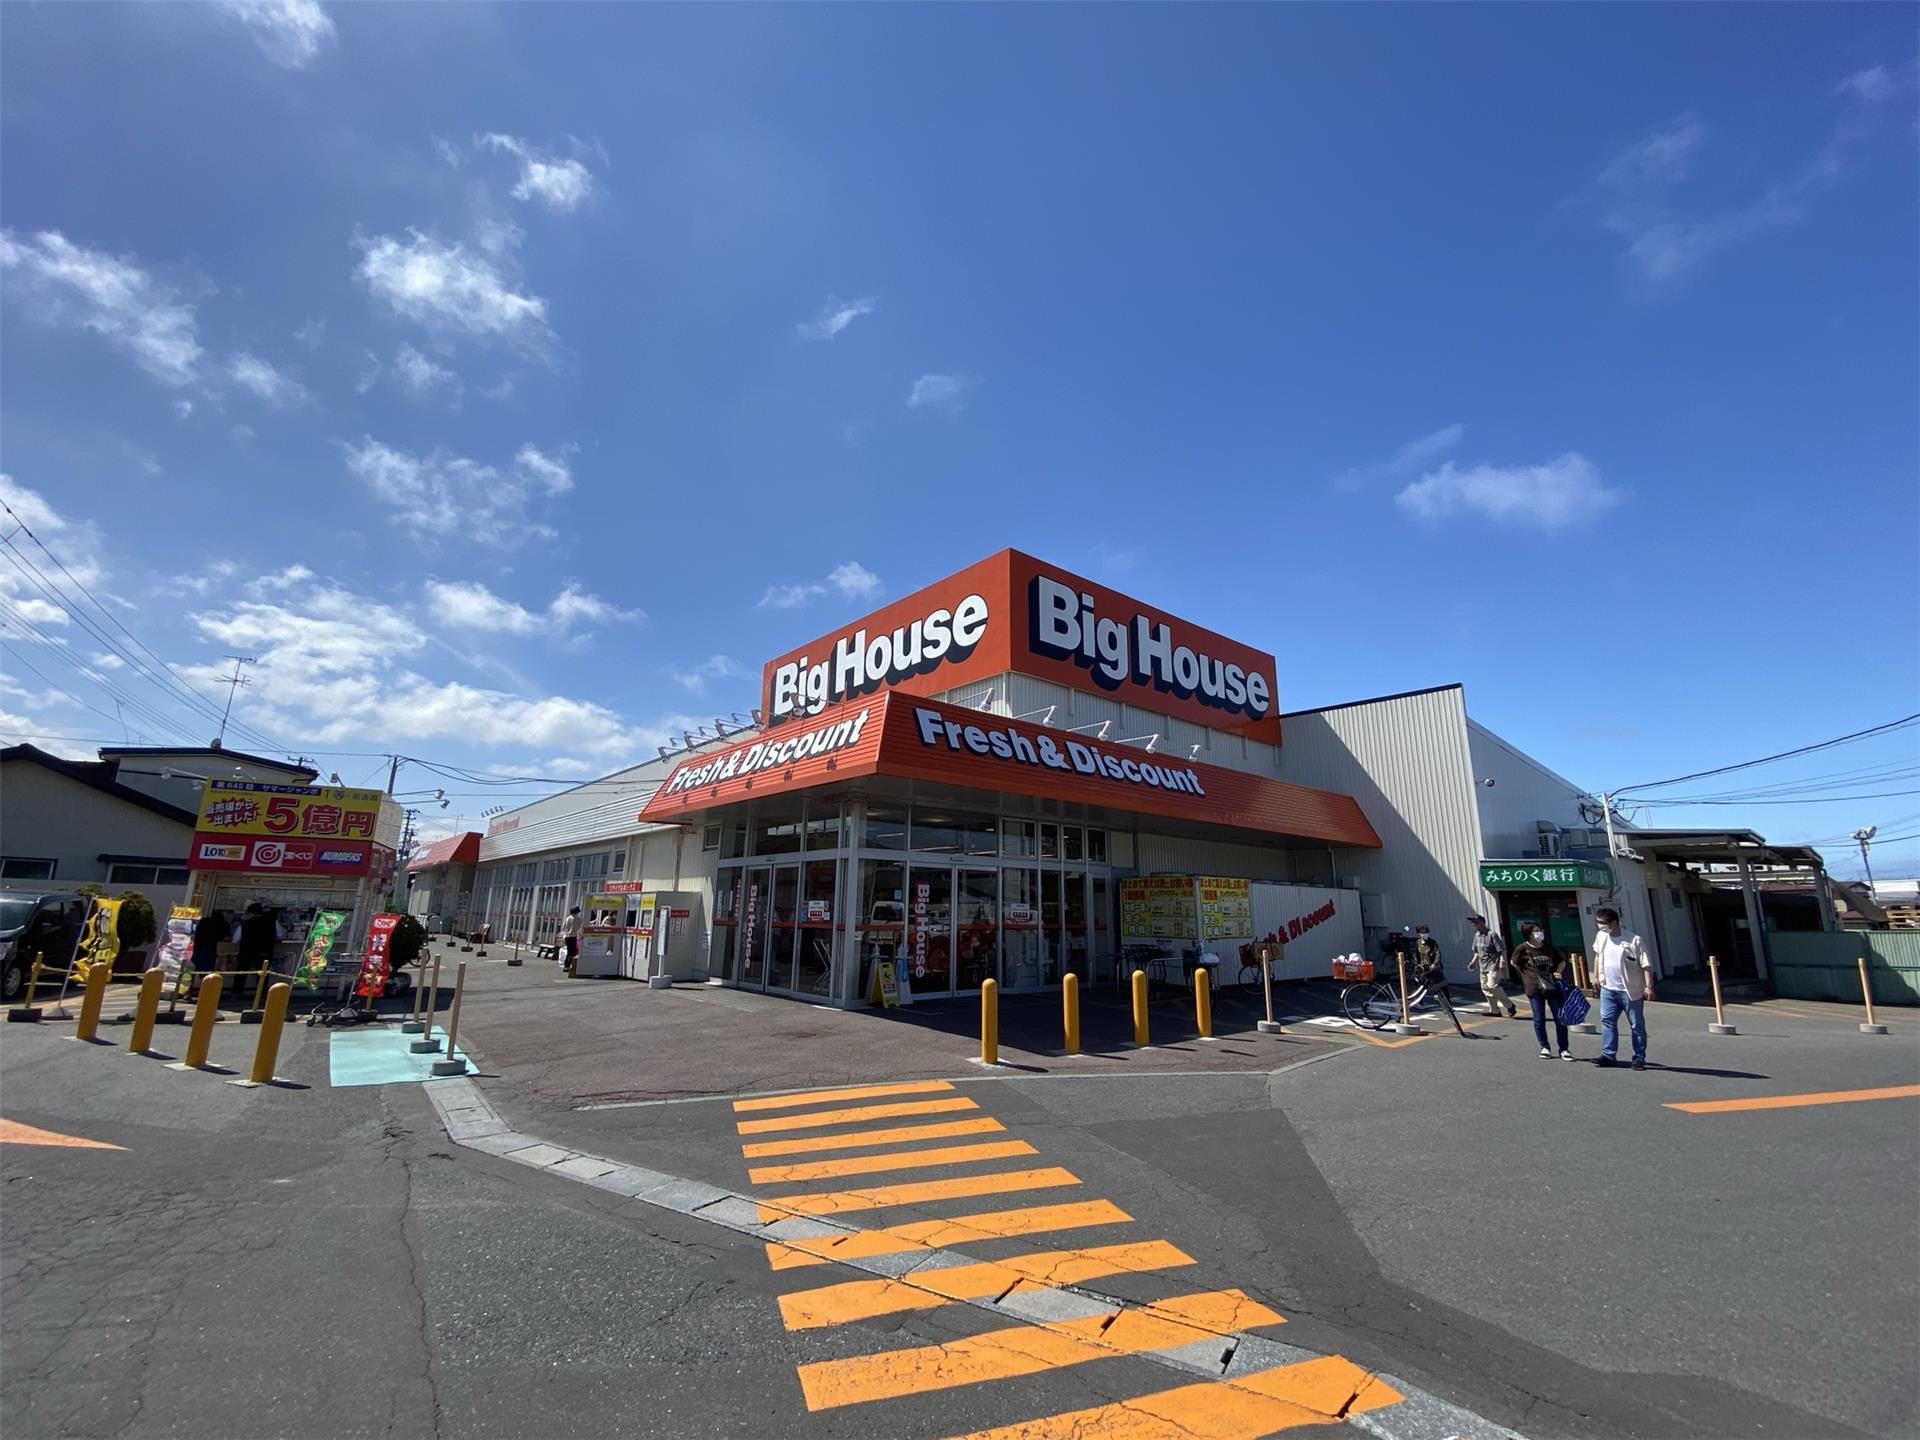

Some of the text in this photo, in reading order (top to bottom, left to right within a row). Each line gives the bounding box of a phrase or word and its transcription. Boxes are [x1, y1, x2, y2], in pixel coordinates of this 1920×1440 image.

[773, 594, 989, 715] Big House
[1037, 574, 1271, 714] Big House
[262, 796, 376, 837] 5億円
[282, 851, 313, 860] 宝くじ
[319, 850, 364, 862] NUMBERS
[1485, 868, 1575, 882] みちのく銀行
[744, 884, 758, 969] Big House
[914, 883, 931, 979] Big House
